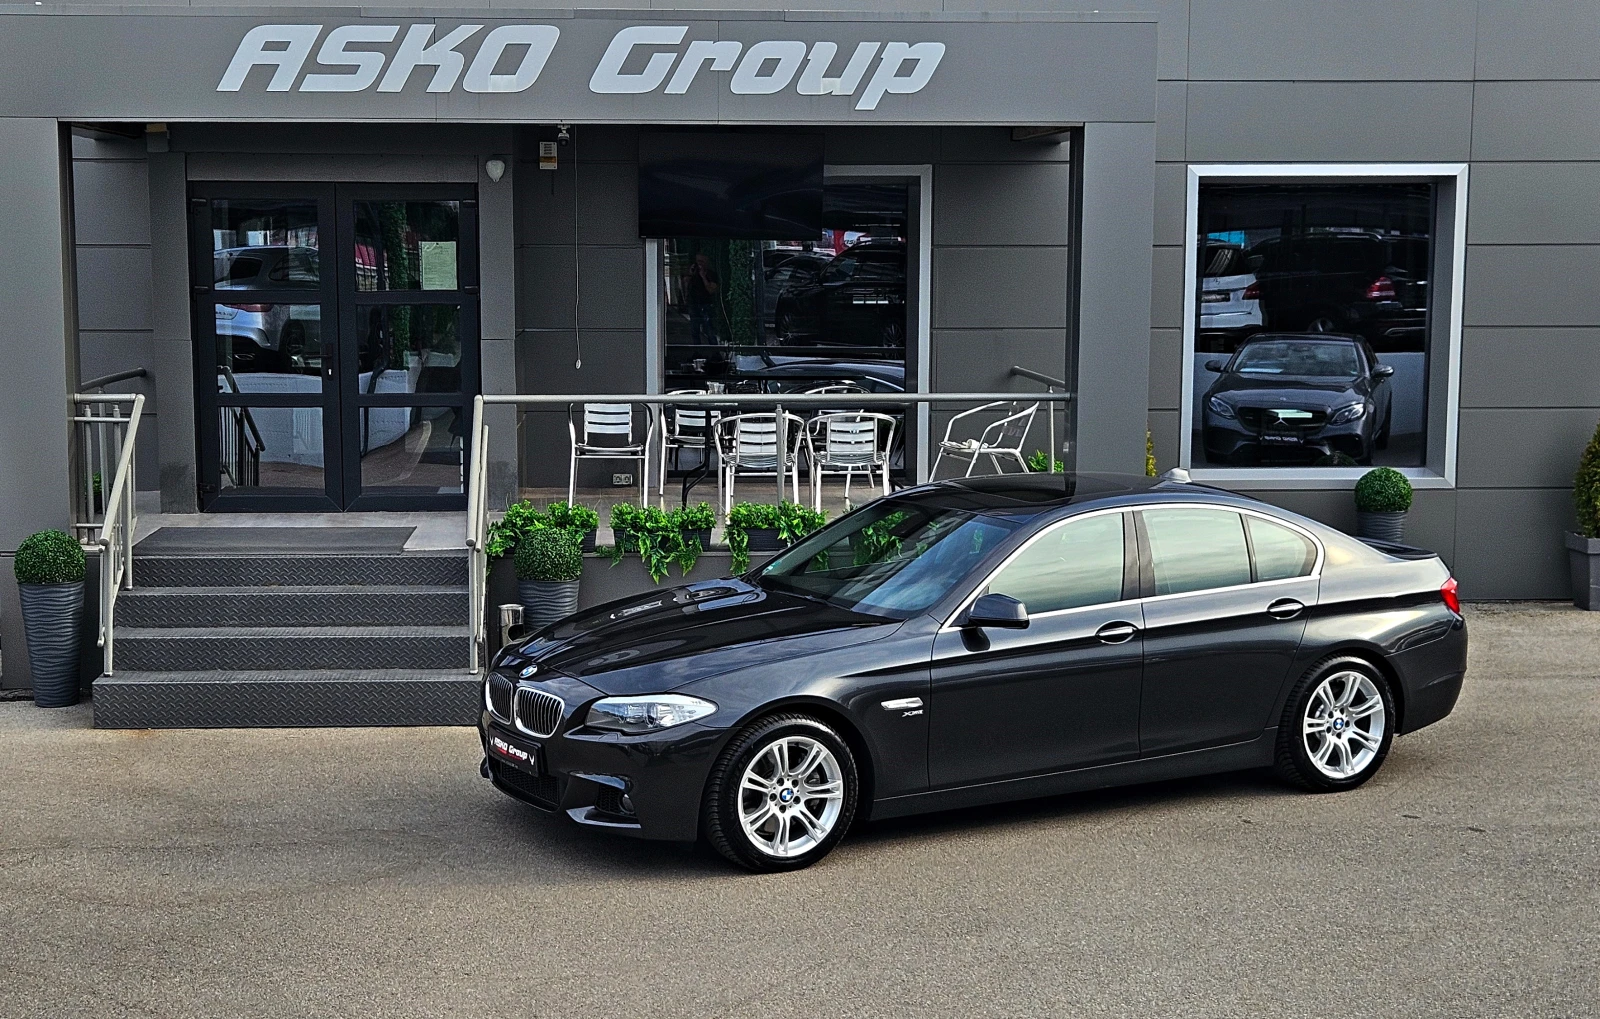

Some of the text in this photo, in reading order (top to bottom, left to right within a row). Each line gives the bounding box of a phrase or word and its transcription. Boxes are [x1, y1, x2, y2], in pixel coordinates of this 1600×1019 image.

[216, 24, 946, 110] ASKO Group
[508, 744, 527, 760] Group
